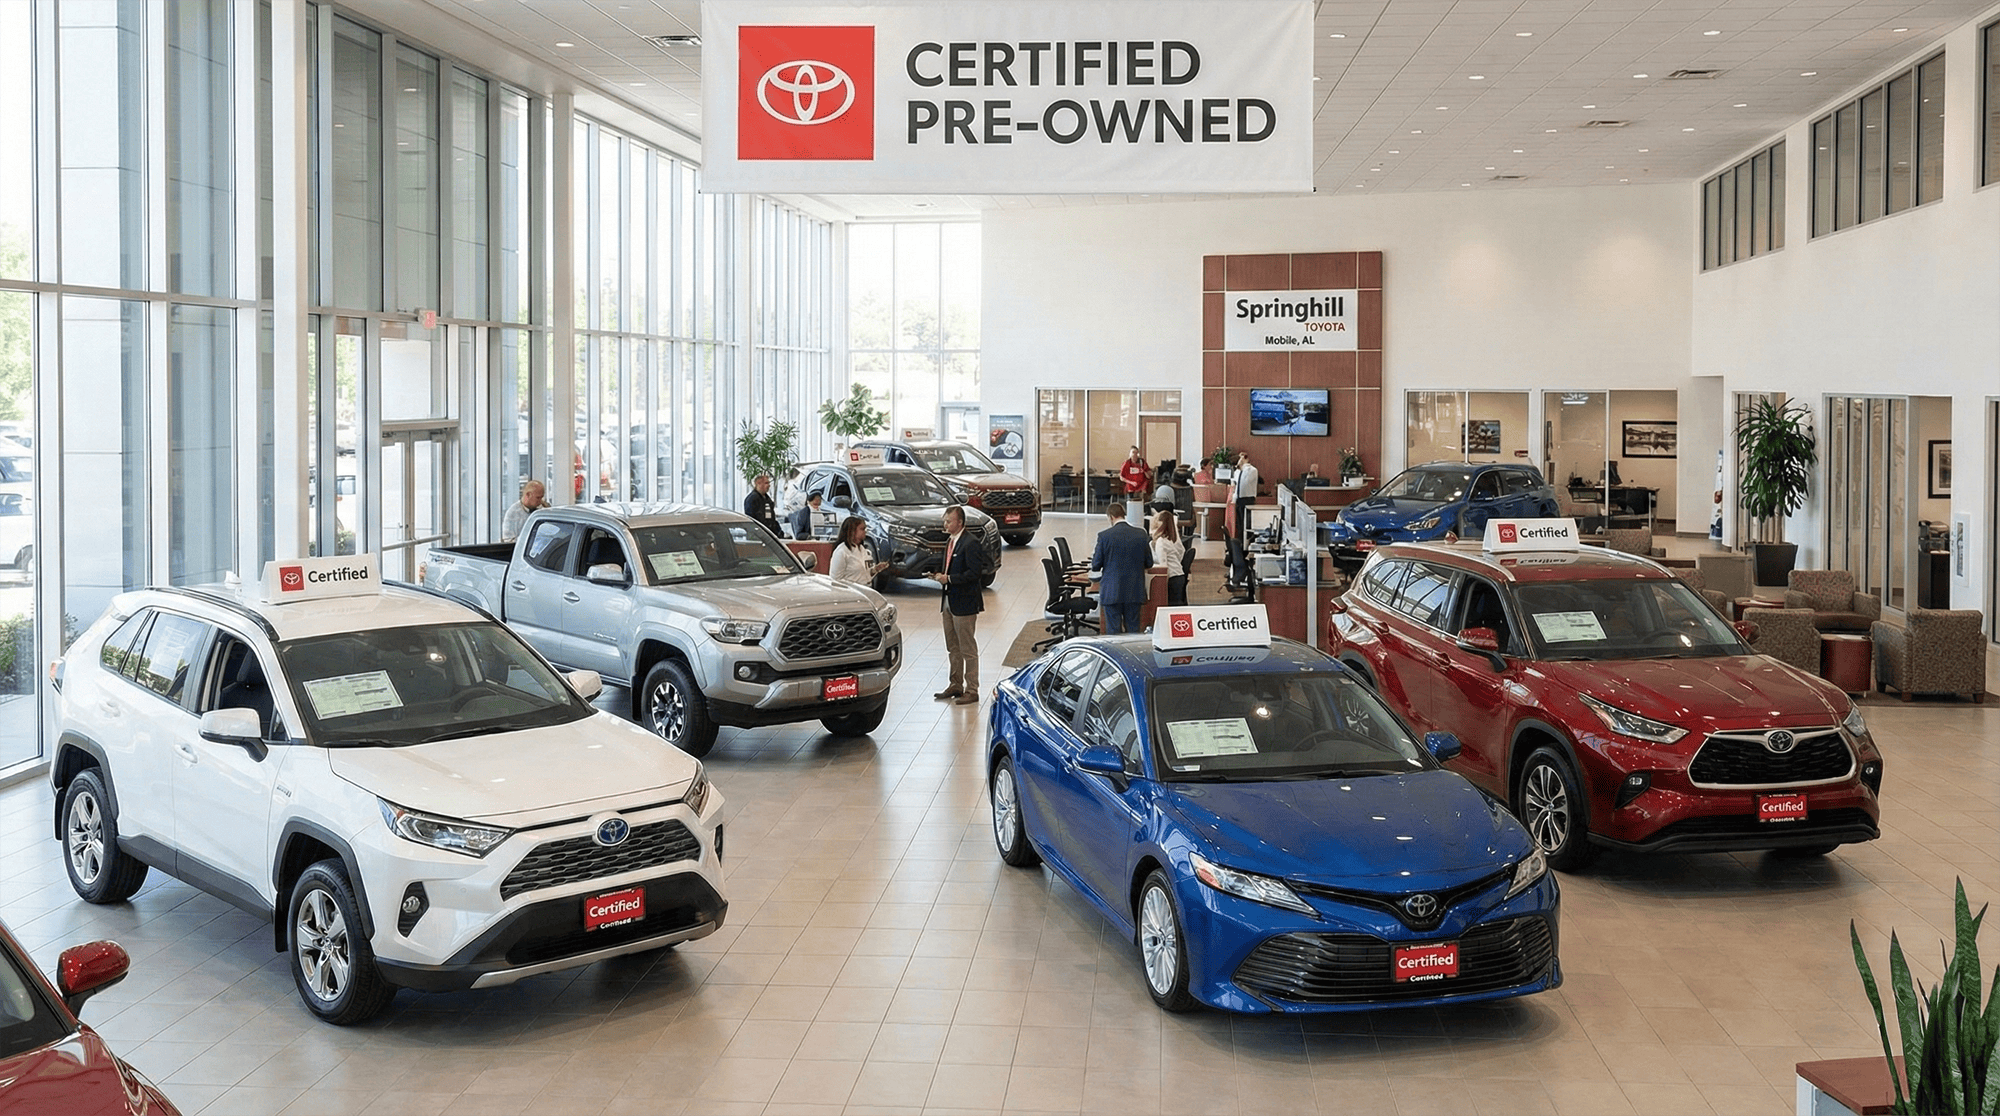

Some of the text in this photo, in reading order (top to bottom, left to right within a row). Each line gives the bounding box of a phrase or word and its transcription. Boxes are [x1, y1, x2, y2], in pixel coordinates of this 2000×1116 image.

[906, 41, 1201, 87] CERTIFIED
[907, 98, 1277, 145] PRE-OWNED
[1236, 296, 1344, 324] Springhill
[1304, 322, 1346, 332] TOYOTA
[1264, 335, 1316, 346] Mobile, AL
[1519, 526, 1569, 539] Certified
[307, 565, 369, 583] Certified
[1197, 616, 1258, 632] Certified
[1761, 800, 1804, 813] Certified
[589, 896, 641, 918] Certified
[1398, 952, 1454, 970] Certified
